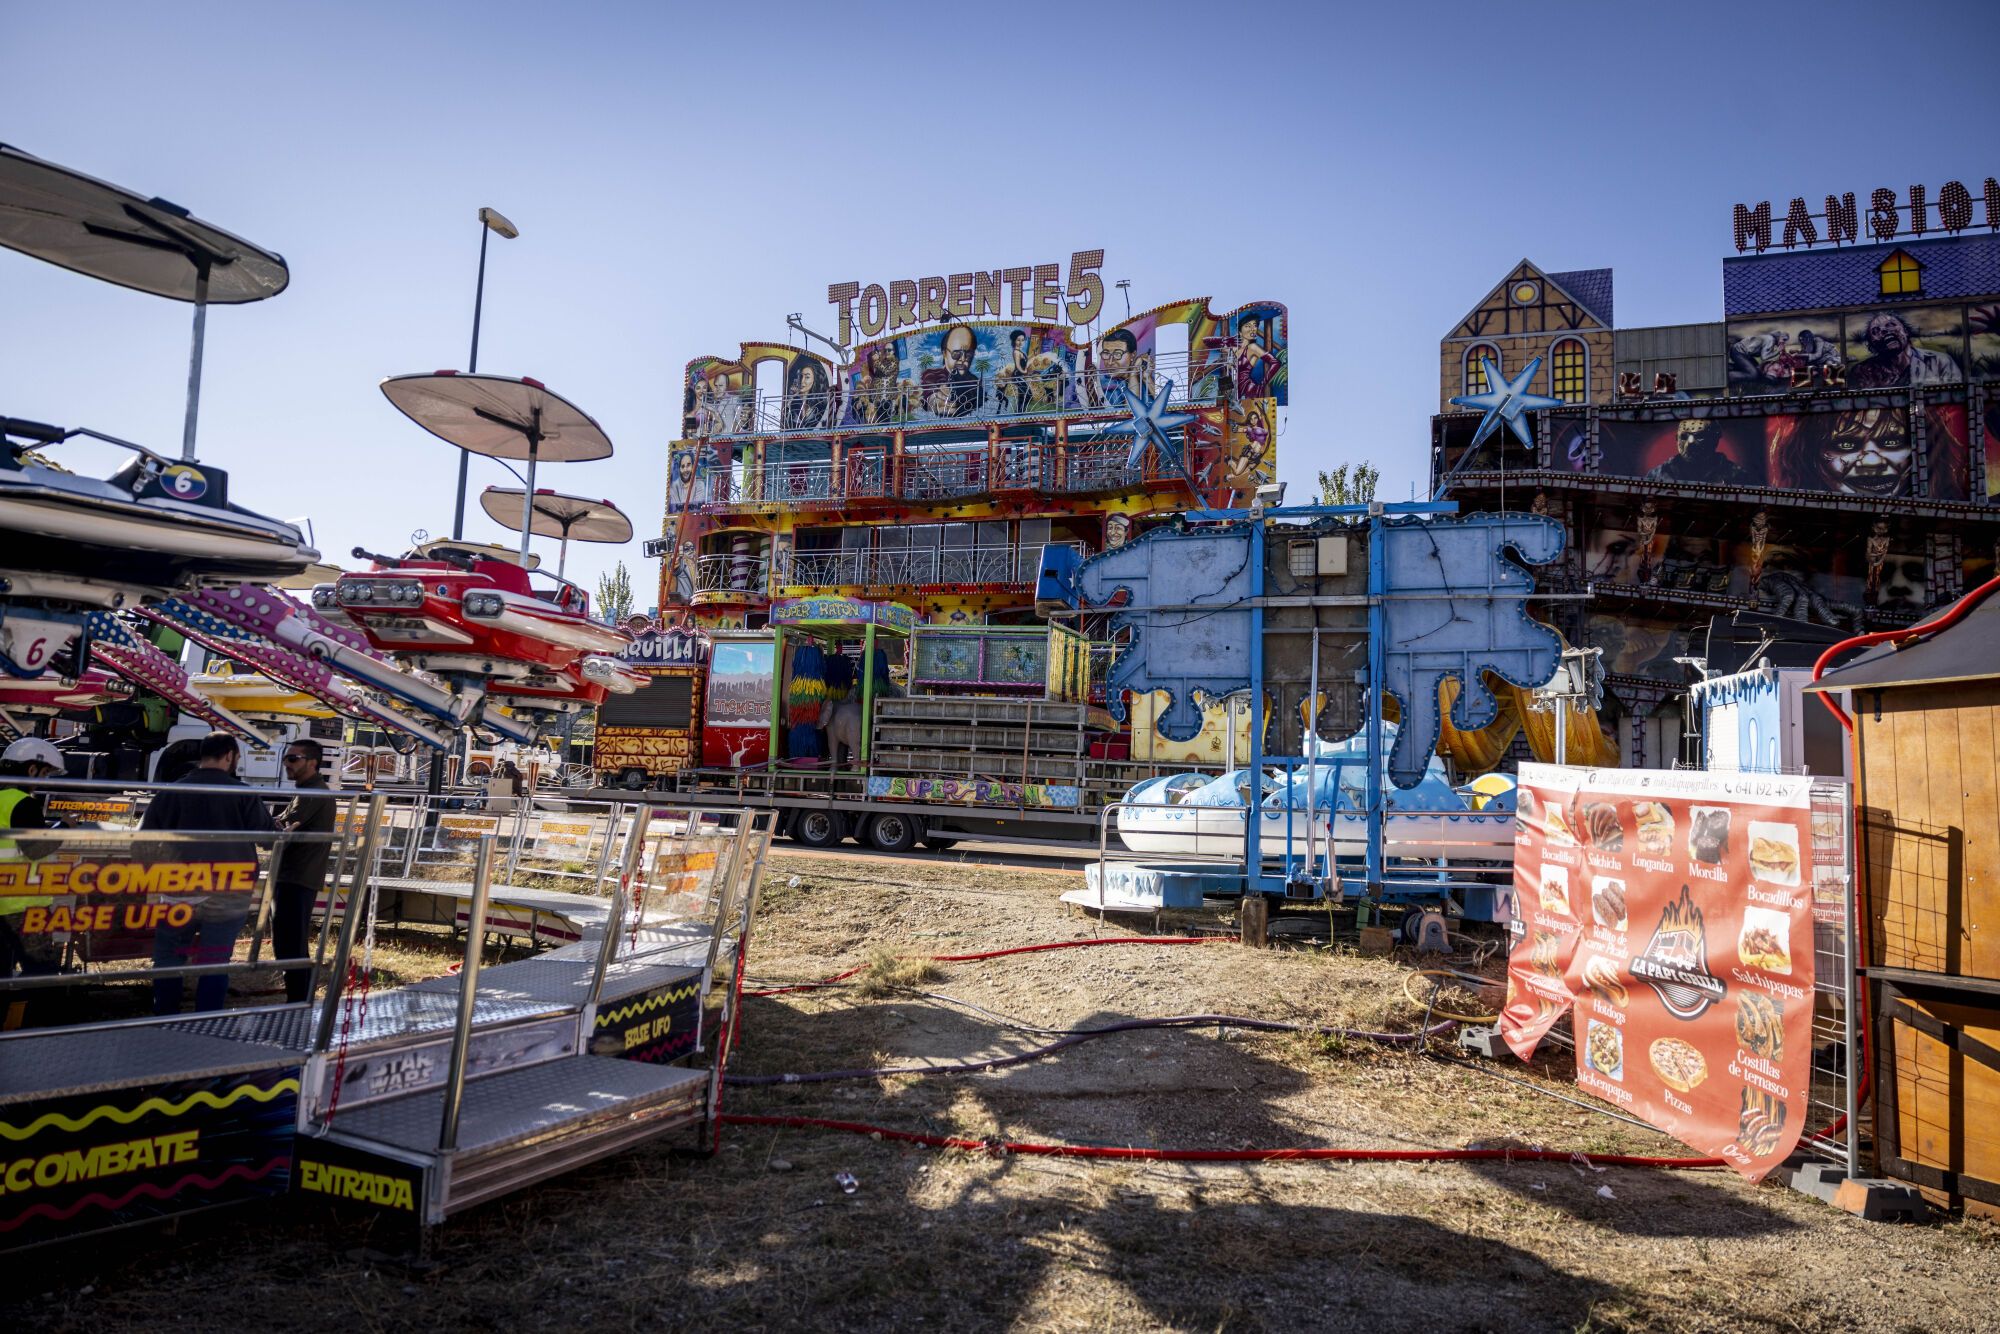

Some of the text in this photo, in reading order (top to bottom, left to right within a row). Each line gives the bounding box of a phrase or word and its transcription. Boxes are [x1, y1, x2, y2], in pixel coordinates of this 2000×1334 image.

[828, 249, 1105, 347] TORRENTE 5
[174, 470, 193, 493] 6
[777, 602, 811, 619] SUPER
[820, 601, 860, 617] RATON
[26, 638, 47, 666] 6
[714, 698, 771, 716] TICKETS
[892, 778, 975, 799] SUPER
[1735, 782, 1751, 795] 641
[1756, 783, 1772, 797] 192
[1541, 847, 1575, 865] Bocadillos
[1588, 853, 1622, 871] Salchicha
[1632, 853, 1674, 873] Longaniza
[1689, 862, 1728, 883] Morcilla
[1747, 884, 1804, 910] Bocadillos
[22, 903, 194, 934] BASE UFO
[1533, 912, 1574, 934] Salchipapas
[1593, 925, 1627, 946] Rollito de
[1632, 958, 1723, 994] LA PAPI GRILL
[1732, 967, 1804, 999] Salchipapas
[1593, 999, 1626, 1025] Hotdogs
[624, 1015, 671, 1050] BASE UFO
[1737, 1048, 1781, 1080] Costillas
[1576, 1066, 1633, 1104] hickenpapas
[1728, 1060, 1789, 1099] de ternasco
[1664, 1088, 1693, 1116] Pizzas
[0, 1129, 200, 1195] COMBATE
[300, 1160, 414, 1211] ENTRADA
